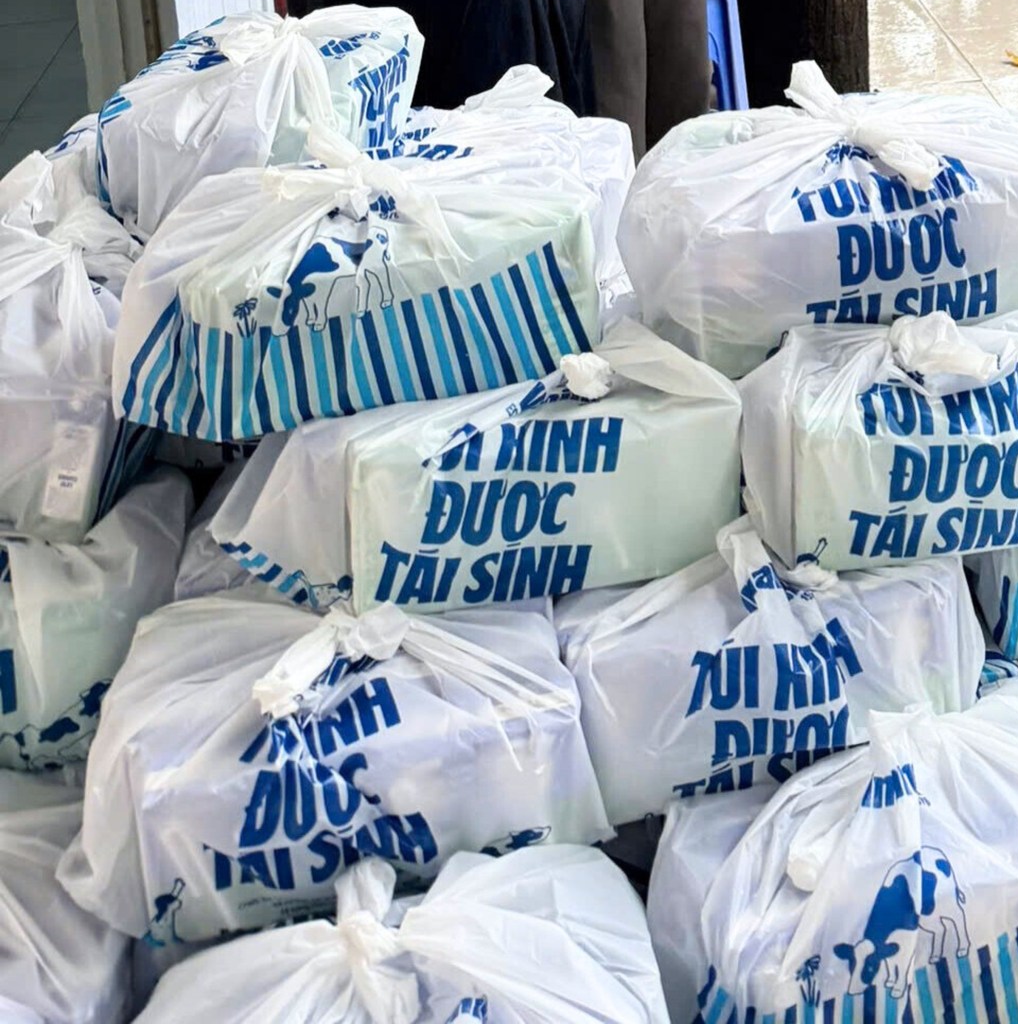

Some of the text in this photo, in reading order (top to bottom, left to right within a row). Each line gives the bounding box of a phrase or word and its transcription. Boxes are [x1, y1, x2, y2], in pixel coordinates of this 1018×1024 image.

[849, 505, 928, 558] TÁI
[374, 540, 592, 605] TÁI SINH
